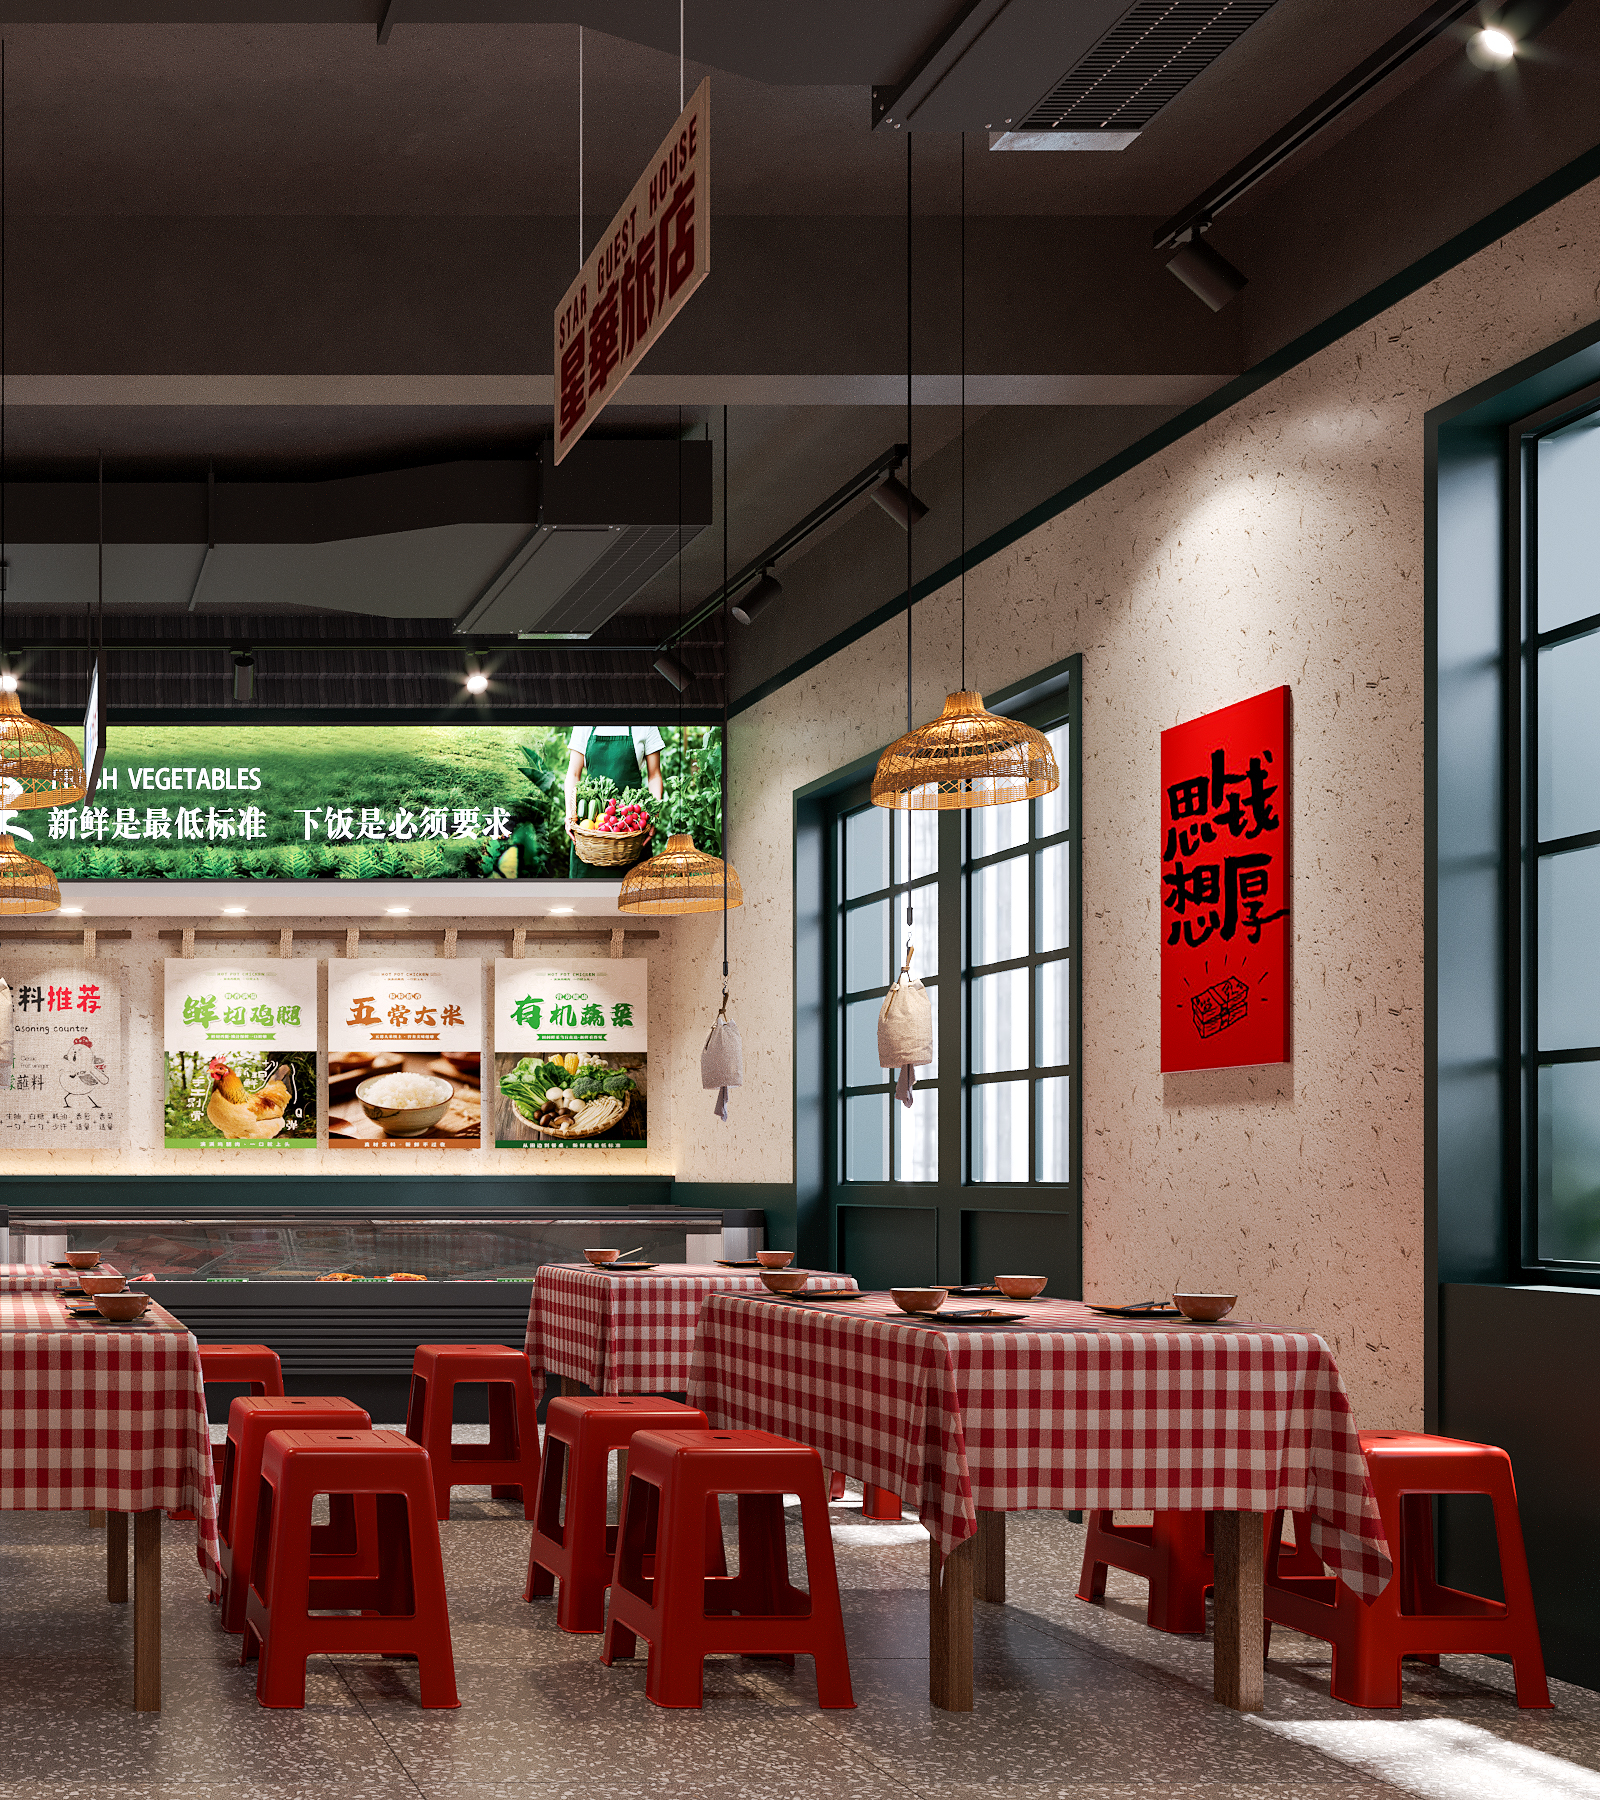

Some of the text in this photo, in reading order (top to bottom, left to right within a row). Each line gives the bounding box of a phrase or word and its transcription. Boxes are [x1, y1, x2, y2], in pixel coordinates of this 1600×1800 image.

[558, 112, 698, 349] STAR GUEST HOUSE
[559, 169, 697, 443] 星華旅店
[128, 766, 262, 791] VEGETABLES
[47, 806, 513, 841] 新鲜是最低标准 下饭是必须要求
[1162, 775, 1221, 948] 思想
[8, 984, 102, 1014] 料推荐
[182, 994, 302, 1029] 鲜切鸡腿
[346, 996, 465, 1027] 五常大米
[510, 993, 634, 1029] 有机蔬菜
[14, 1024, 50, 1035] asoning
[186, 1076, 206, 1122] 手工剔骨
